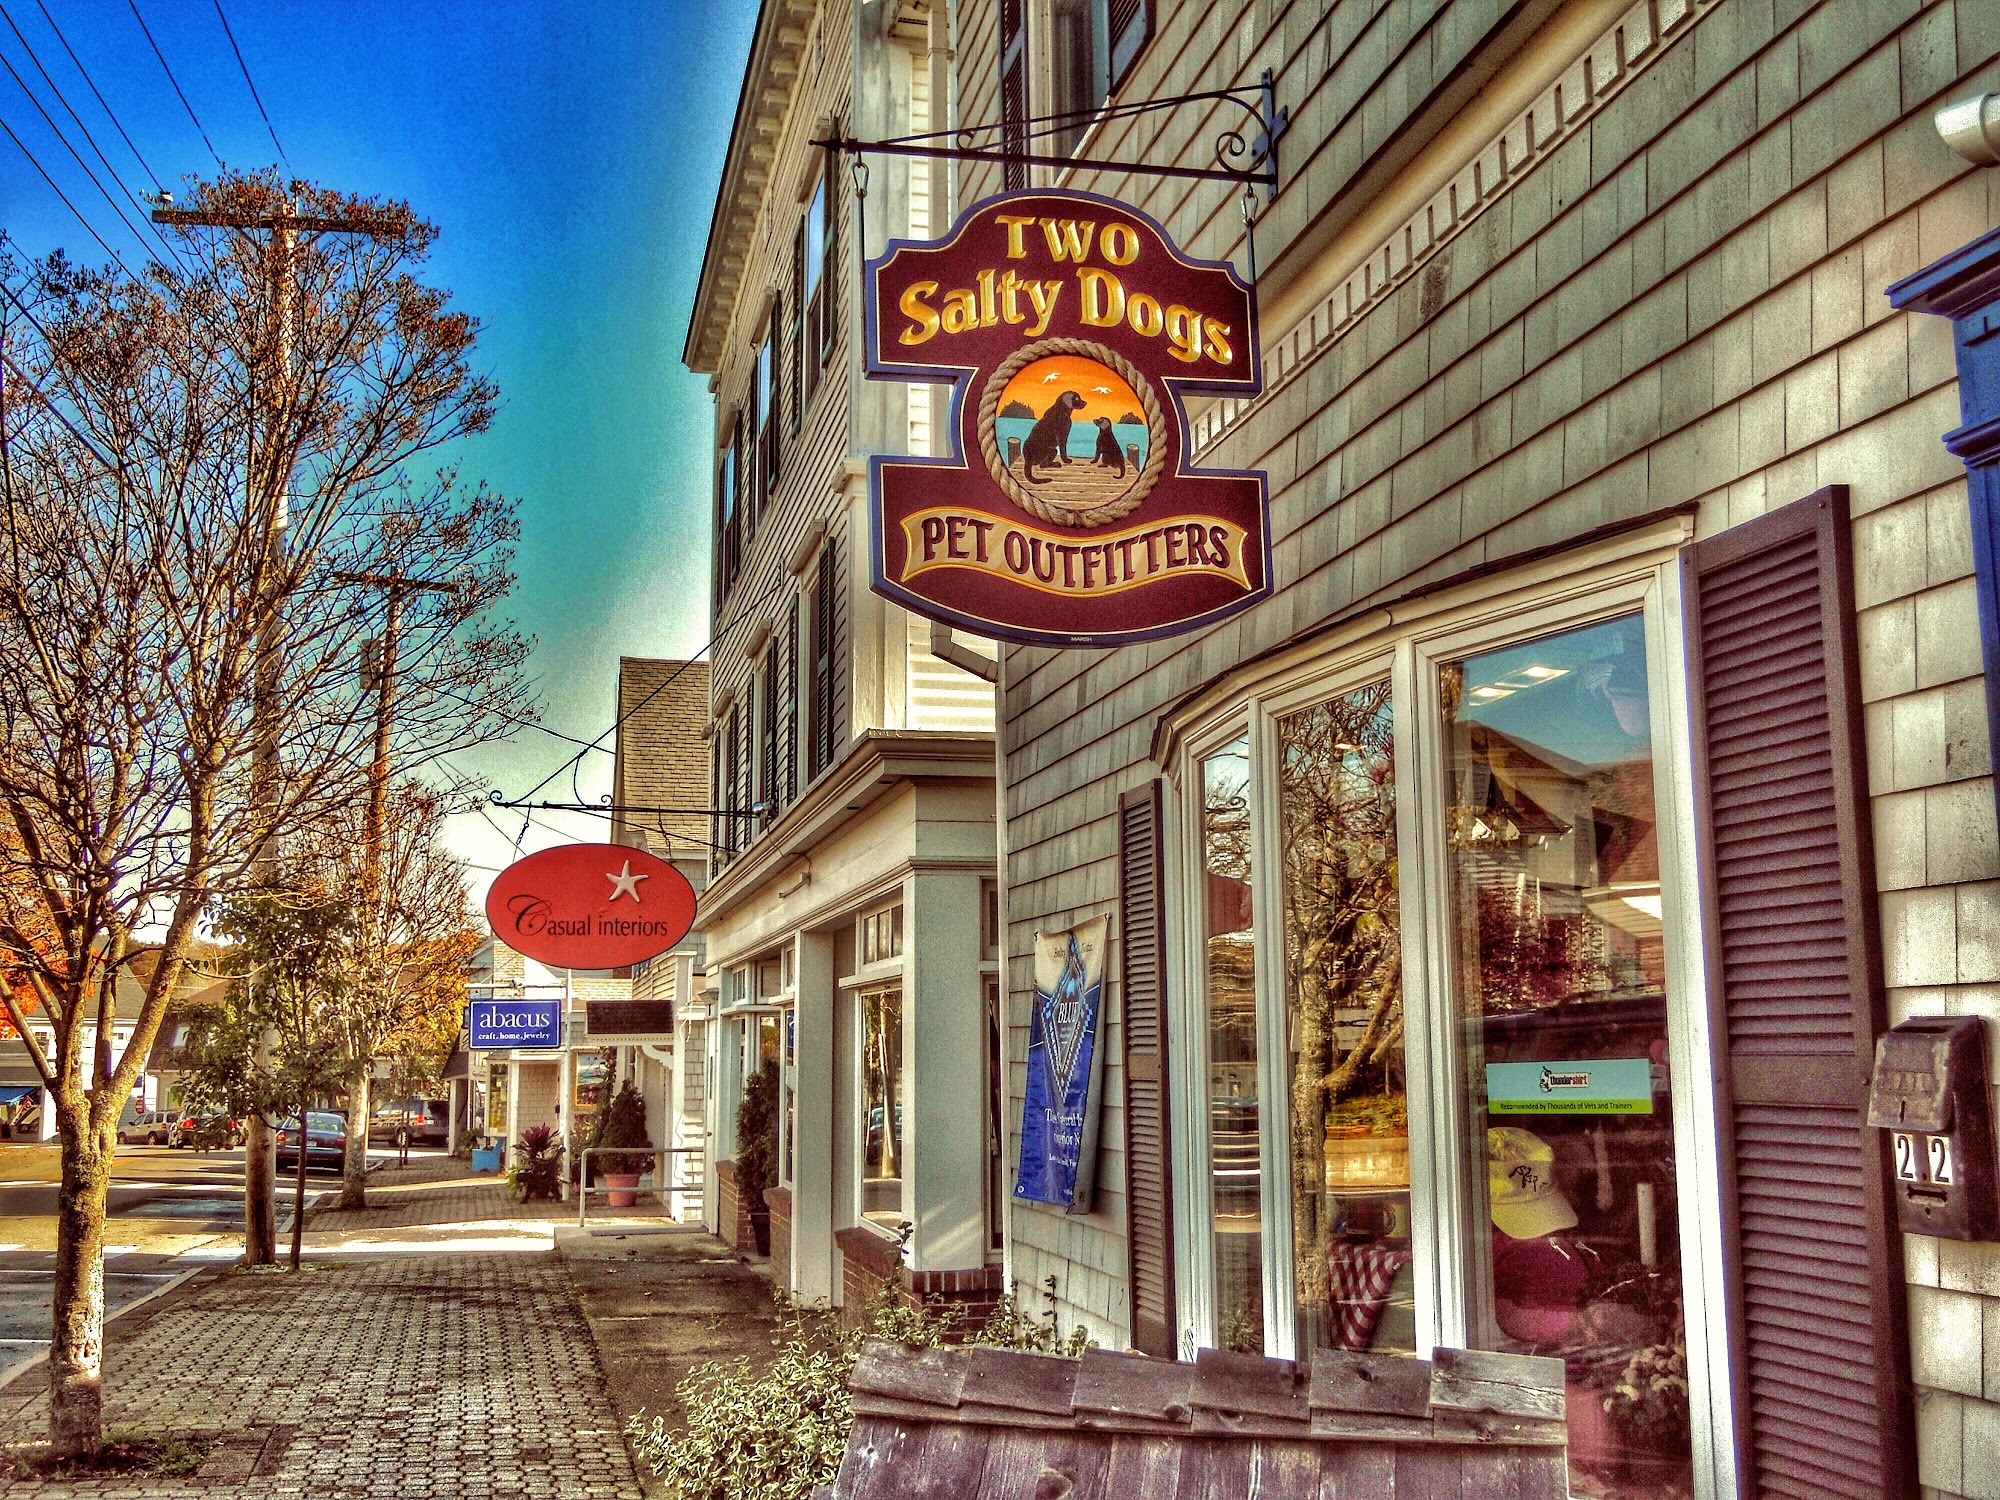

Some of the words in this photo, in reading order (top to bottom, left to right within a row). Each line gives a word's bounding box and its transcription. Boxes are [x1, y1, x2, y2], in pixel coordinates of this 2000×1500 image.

[995, 214, 1140, 266] TWO
[899, 268, 1064, 346] Salty
[1076, 267, 1234, 365] Dogs
[920, 515, 995, 564] PET
[1003, 523, 1233, 590] OUTFITTERS
[507, 894, 591, 937] Casual
[598, 914, 668, 937] interiors
[480, 1005, 550, 1028] abacus
[1539, 1103, 1546, 1111] by
[1547, 1102, 1577, 1110] Thousands
[1577, 1102, 1584, 1110] of
[1598, 1102, 1609, 1110] and
